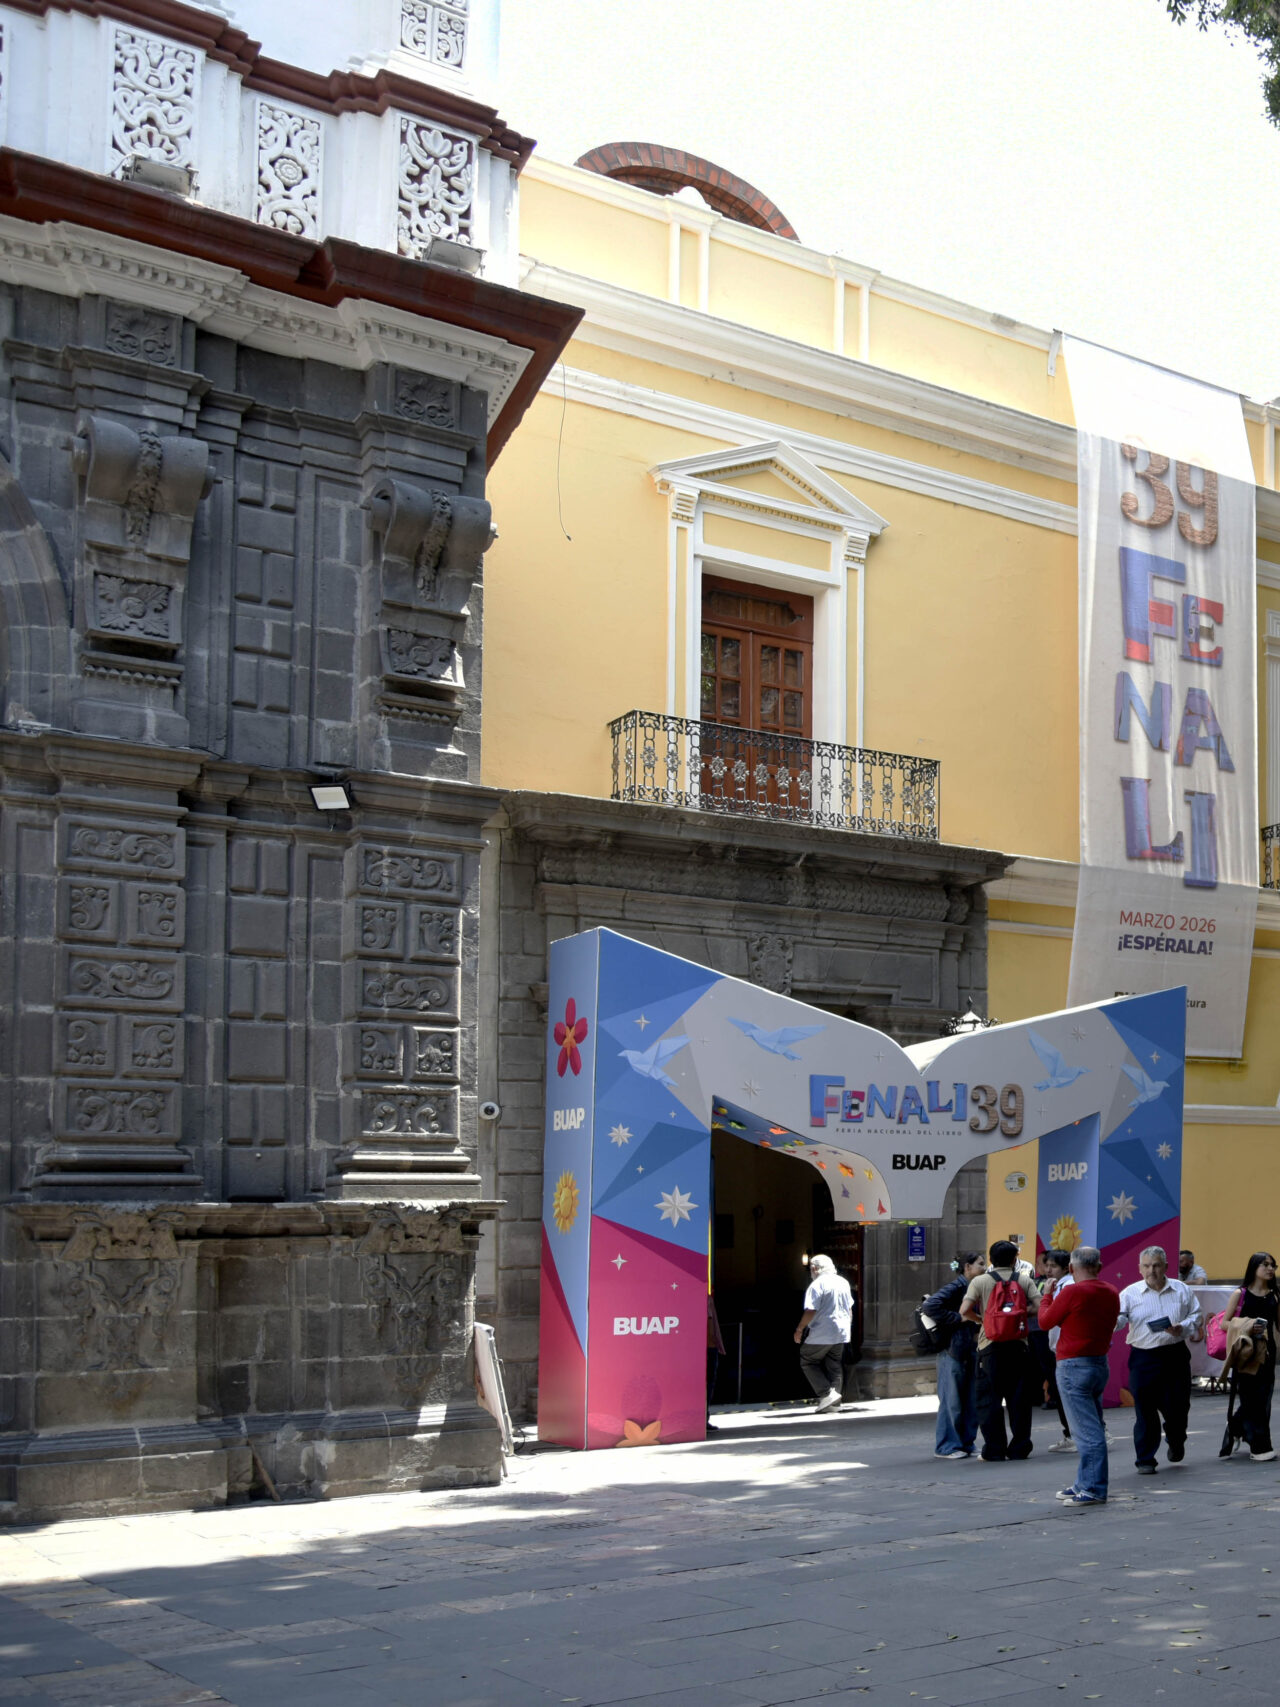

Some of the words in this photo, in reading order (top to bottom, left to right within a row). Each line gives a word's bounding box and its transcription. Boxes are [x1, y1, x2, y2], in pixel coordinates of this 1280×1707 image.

[1120, 434, 1219, 546] 39
[1119, 910, 1176, 930] MARZO
[1179, 916, 1216, 934] 2026
[1117, 932, 1213, 955] ¡ESPÉRALA!
[809, 1074, 967, 1128] FENALI
[968, 1083, 1025, 1137] 39
[553, 1107, 585, 1131] BUAP
[892, 1154, 946, 1171] BUAP
[1047, 1162, 1088, 1181] BUAP
[613, 1316, 680, 1336] BUAP
